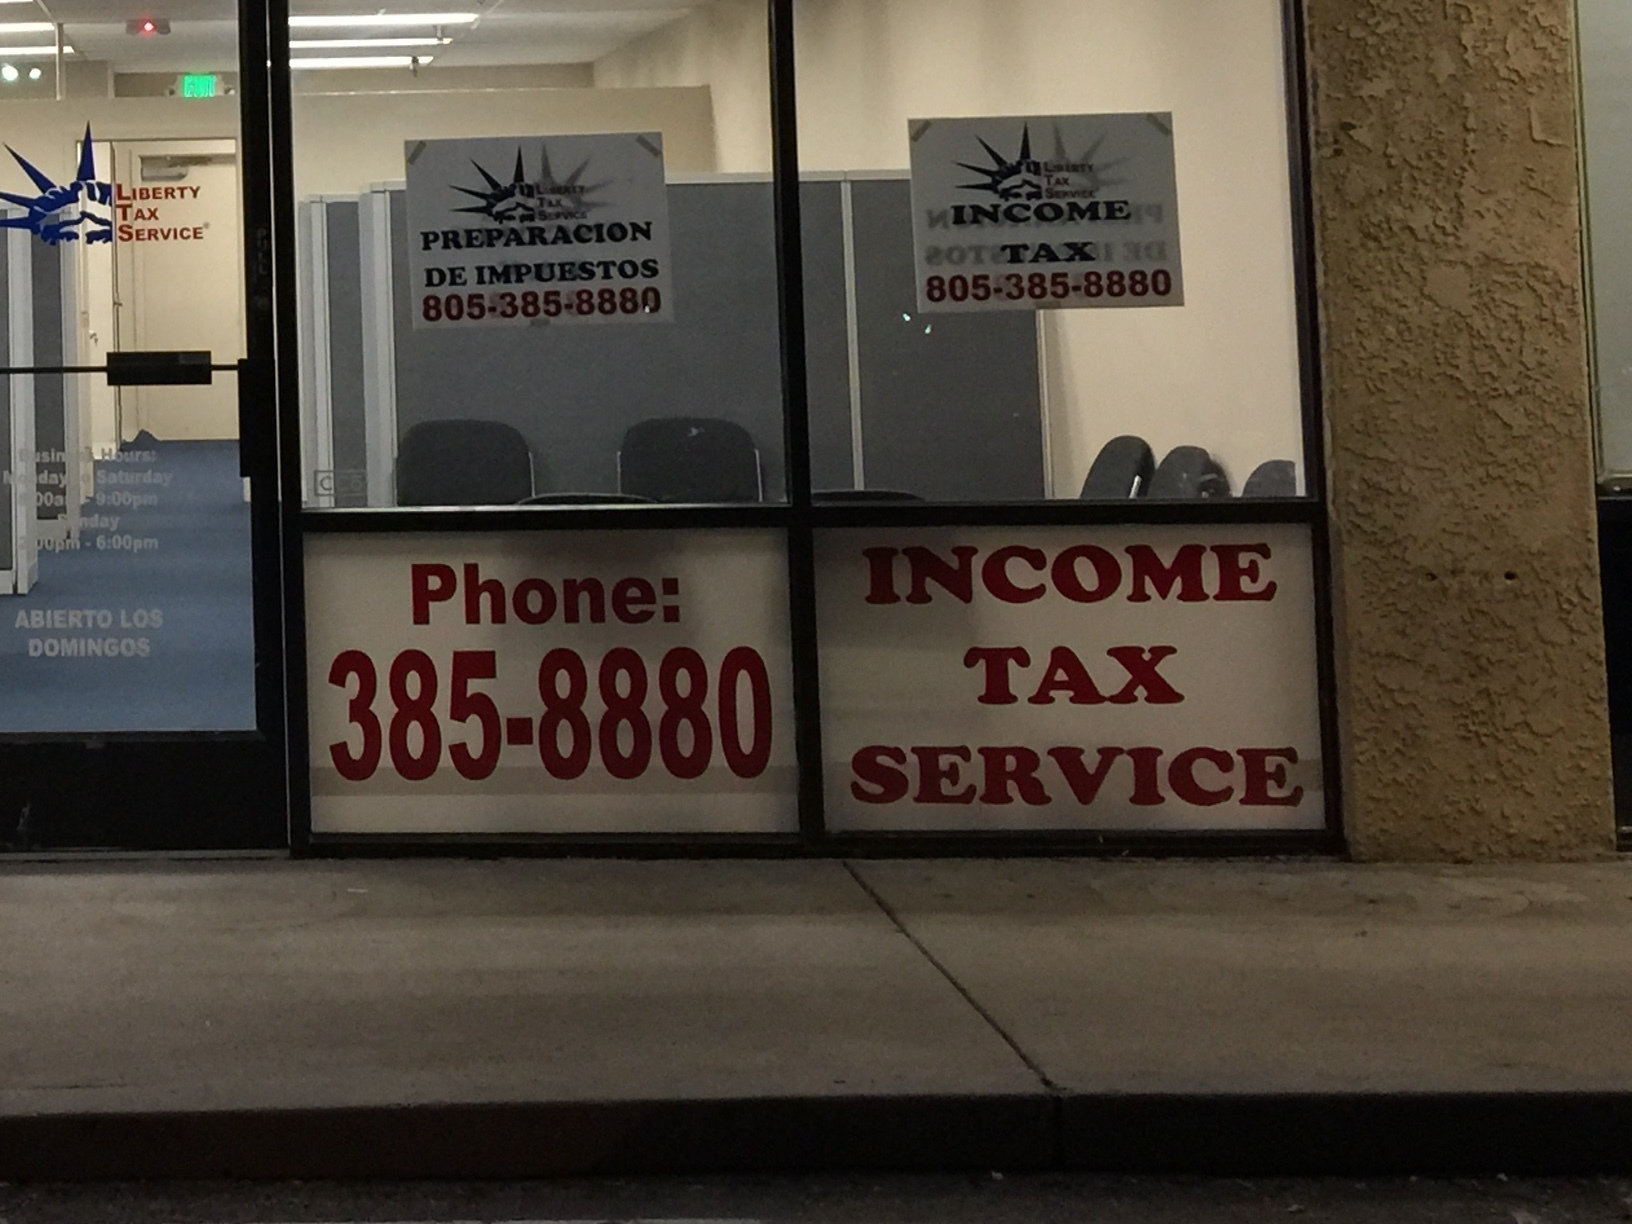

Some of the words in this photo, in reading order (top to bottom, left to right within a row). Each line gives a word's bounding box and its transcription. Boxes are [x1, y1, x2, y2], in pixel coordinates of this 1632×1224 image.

[1044, 174, 1070, 186] TAX
[116, 183, 201, 201] LIBERTY
[536, 197, 563, 208] TAX
[115, 204, 159, 221] TAX
[951, 200, 1132, 225] INCOME
[118, 224, 203, 242] SERVICE
[421, 221, 653, 251] PREPARACION
[1000, 241, 1097, 264] TAX
[424, 266, 468, 287] DE
[475, 259, 659, 285] IMPUESTOS
[926, 269, 1172, 302] 805-385-8880
[422, 286, 661, 322] 805-385-8880
[101, 447, 157, 463] Hours:
[96, 469, 174, 487] Saturday
[57, 513, 121, 531] Snday
[862, 542, 1277, 605] INCOME
[411, 562, 681, 626] Phone:
[15, 609, 113, 629] ABIERTO
[120, 608, 164, 629] LOS
[28, 637, 151, 657] DOMINGOS
[962, 645, 1185, 705] TAX
[328, 646, 772, 782] 385-8880
[850, 744, 1304, 808] SERVICE
